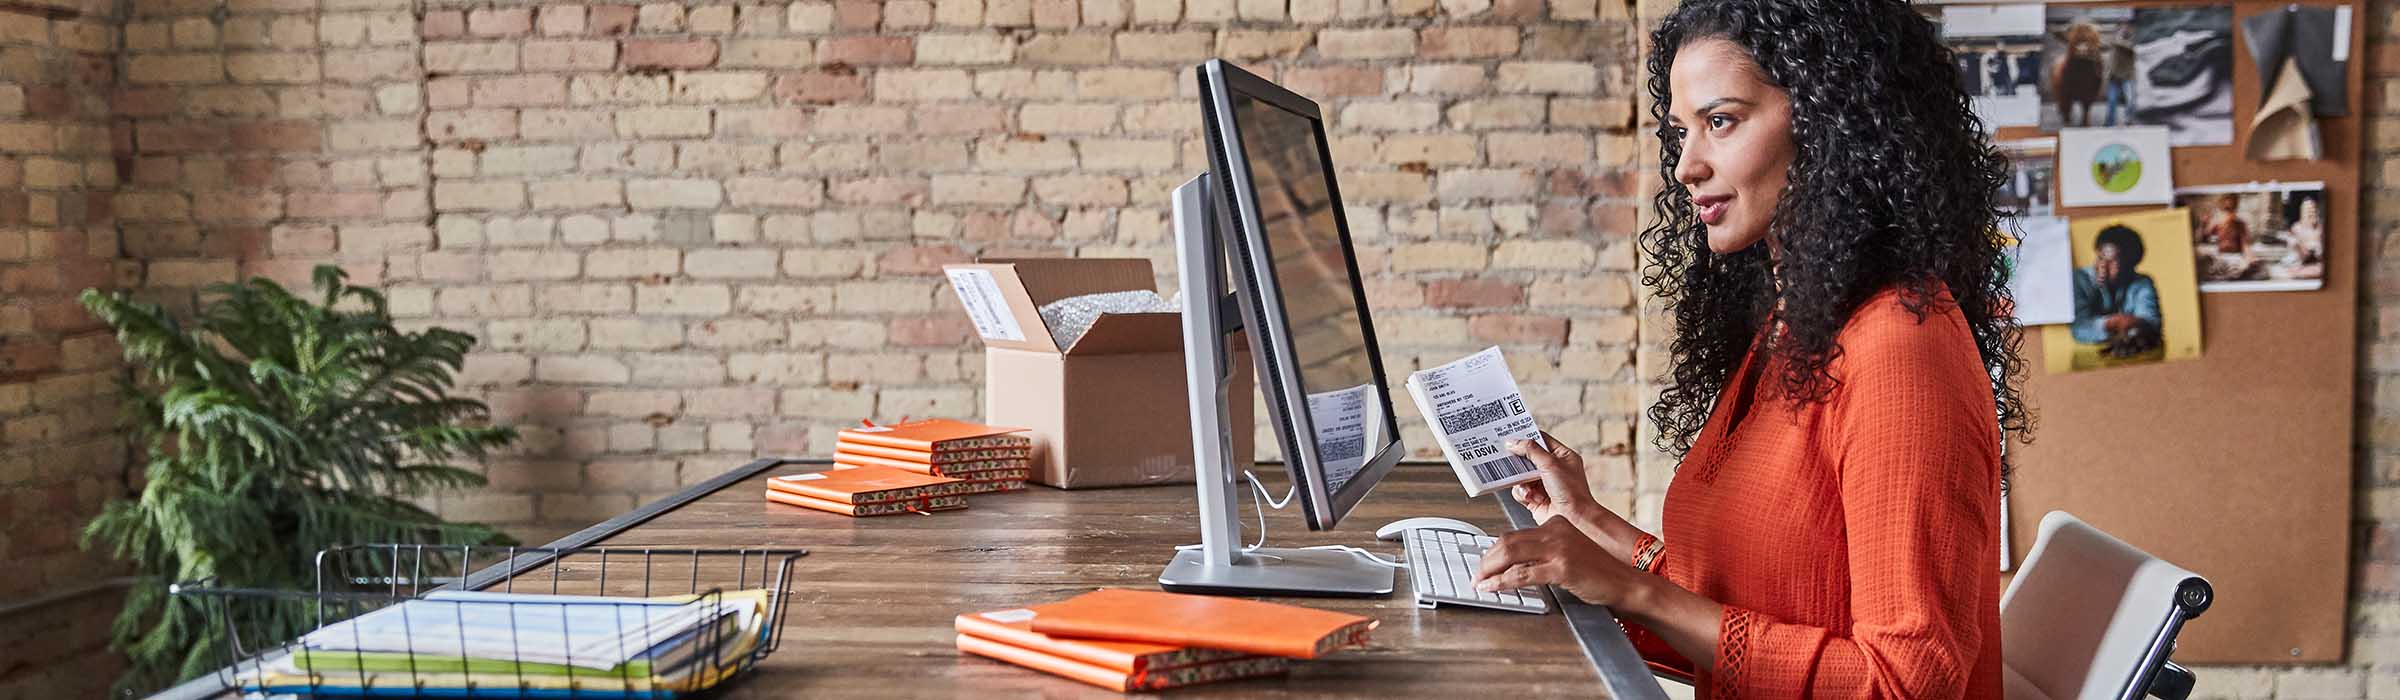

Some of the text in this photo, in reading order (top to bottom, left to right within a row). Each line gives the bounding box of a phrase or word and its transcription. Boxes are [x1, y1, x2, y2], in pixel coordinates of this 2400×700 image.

[1513, 401, 1522, 411] E
[1460, 451, 1475, 462] XH
[1474, 444, 1499, 458] DSVA
